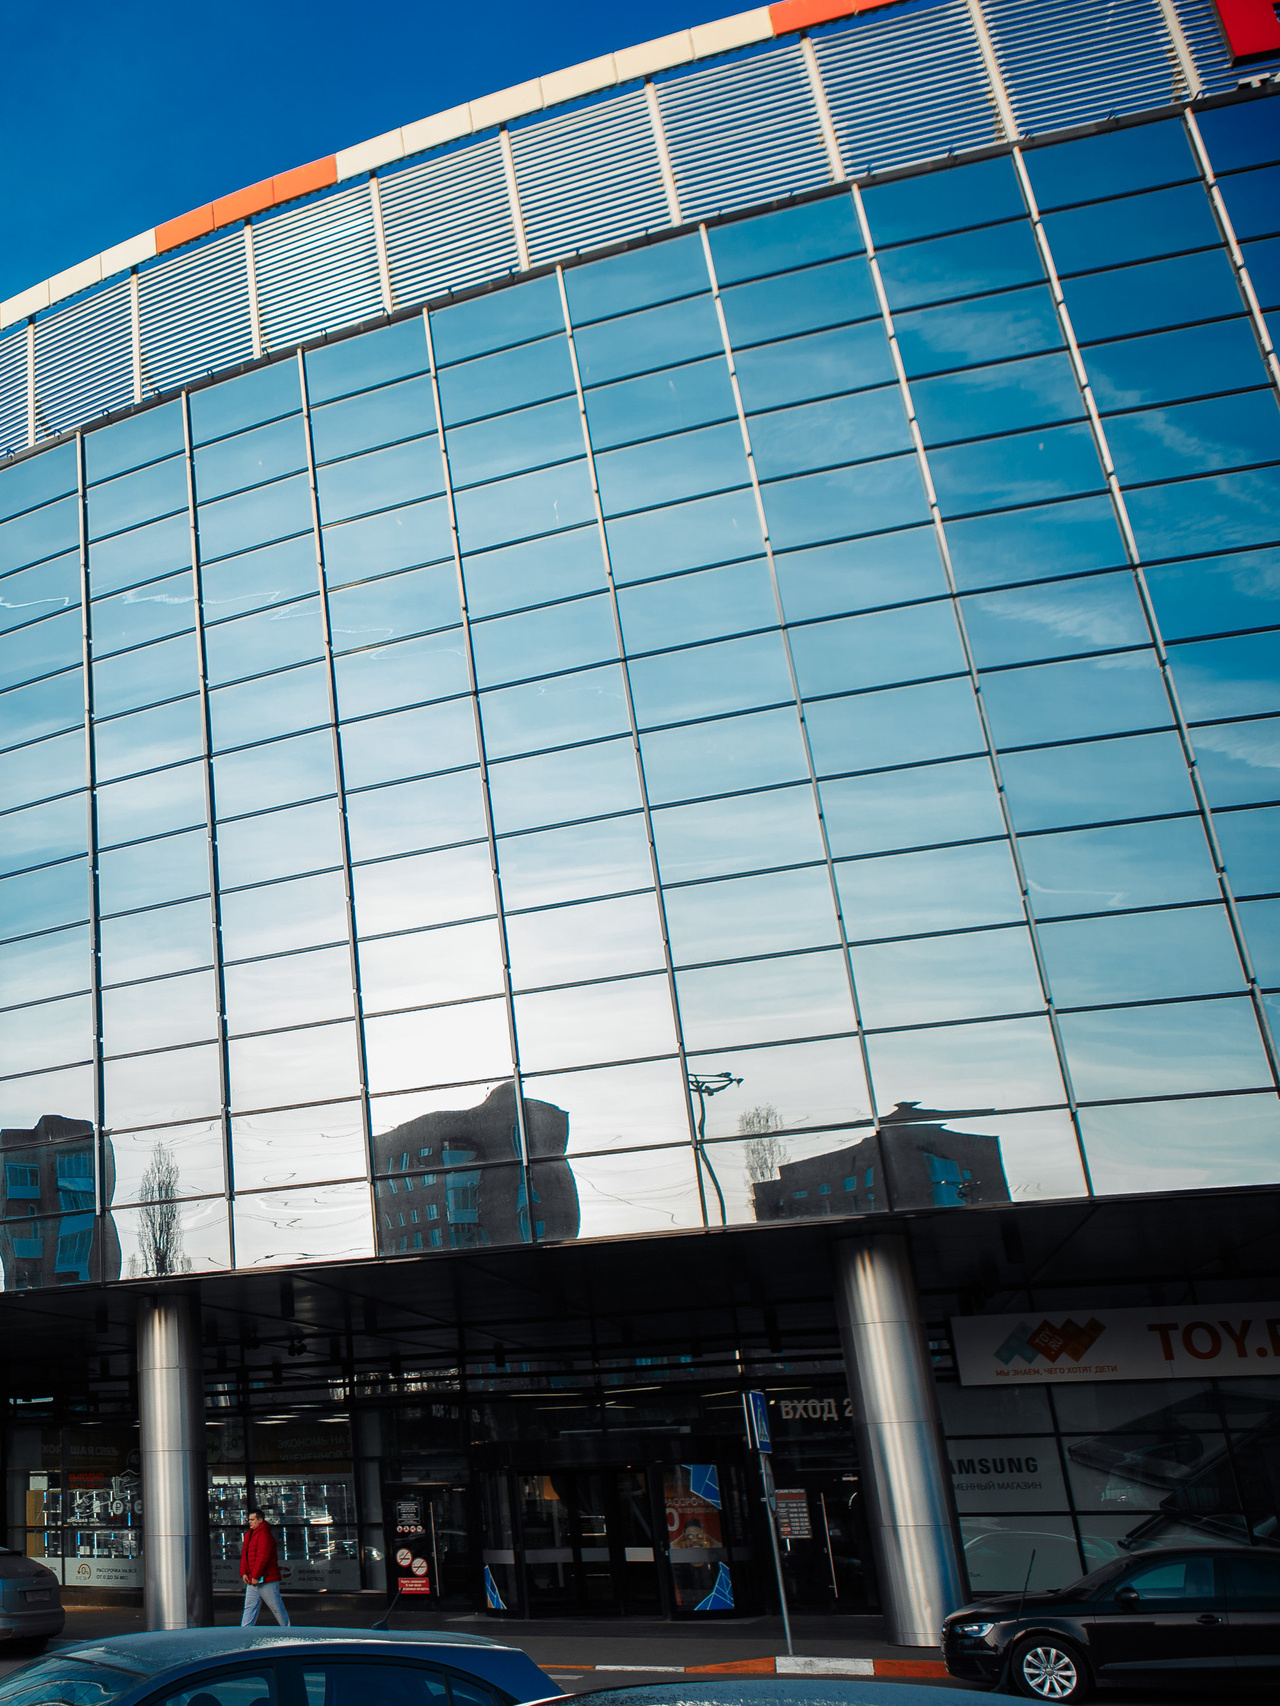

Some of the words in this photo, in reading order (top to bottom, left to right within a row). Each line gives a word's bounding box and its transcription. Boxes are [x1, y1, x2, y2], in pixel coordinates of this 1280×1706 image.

[1034, 1327, 1053, 1347] TOY
[995, 1369, 1009, 1377] МЫ
[1011, 1368, 1043, 1377] ЗНАЕМ,
[1044, 1367, 1065, 1375] ЧЕГО
[1067, 1366, 1092, 1374] ХОТЯТ
[1094, 1365, 1118, 1374] ДЕТИ
[780, 1398, 839, 1421] ВХОД
[843, 1398, 854, 1417] 2
[950, 1457, 1039, 1475] MSUNG
[953, 1480, 996, 1491] МЕННЫЙ
[997, 1481, 1042, 1491] МАГАЗИН
